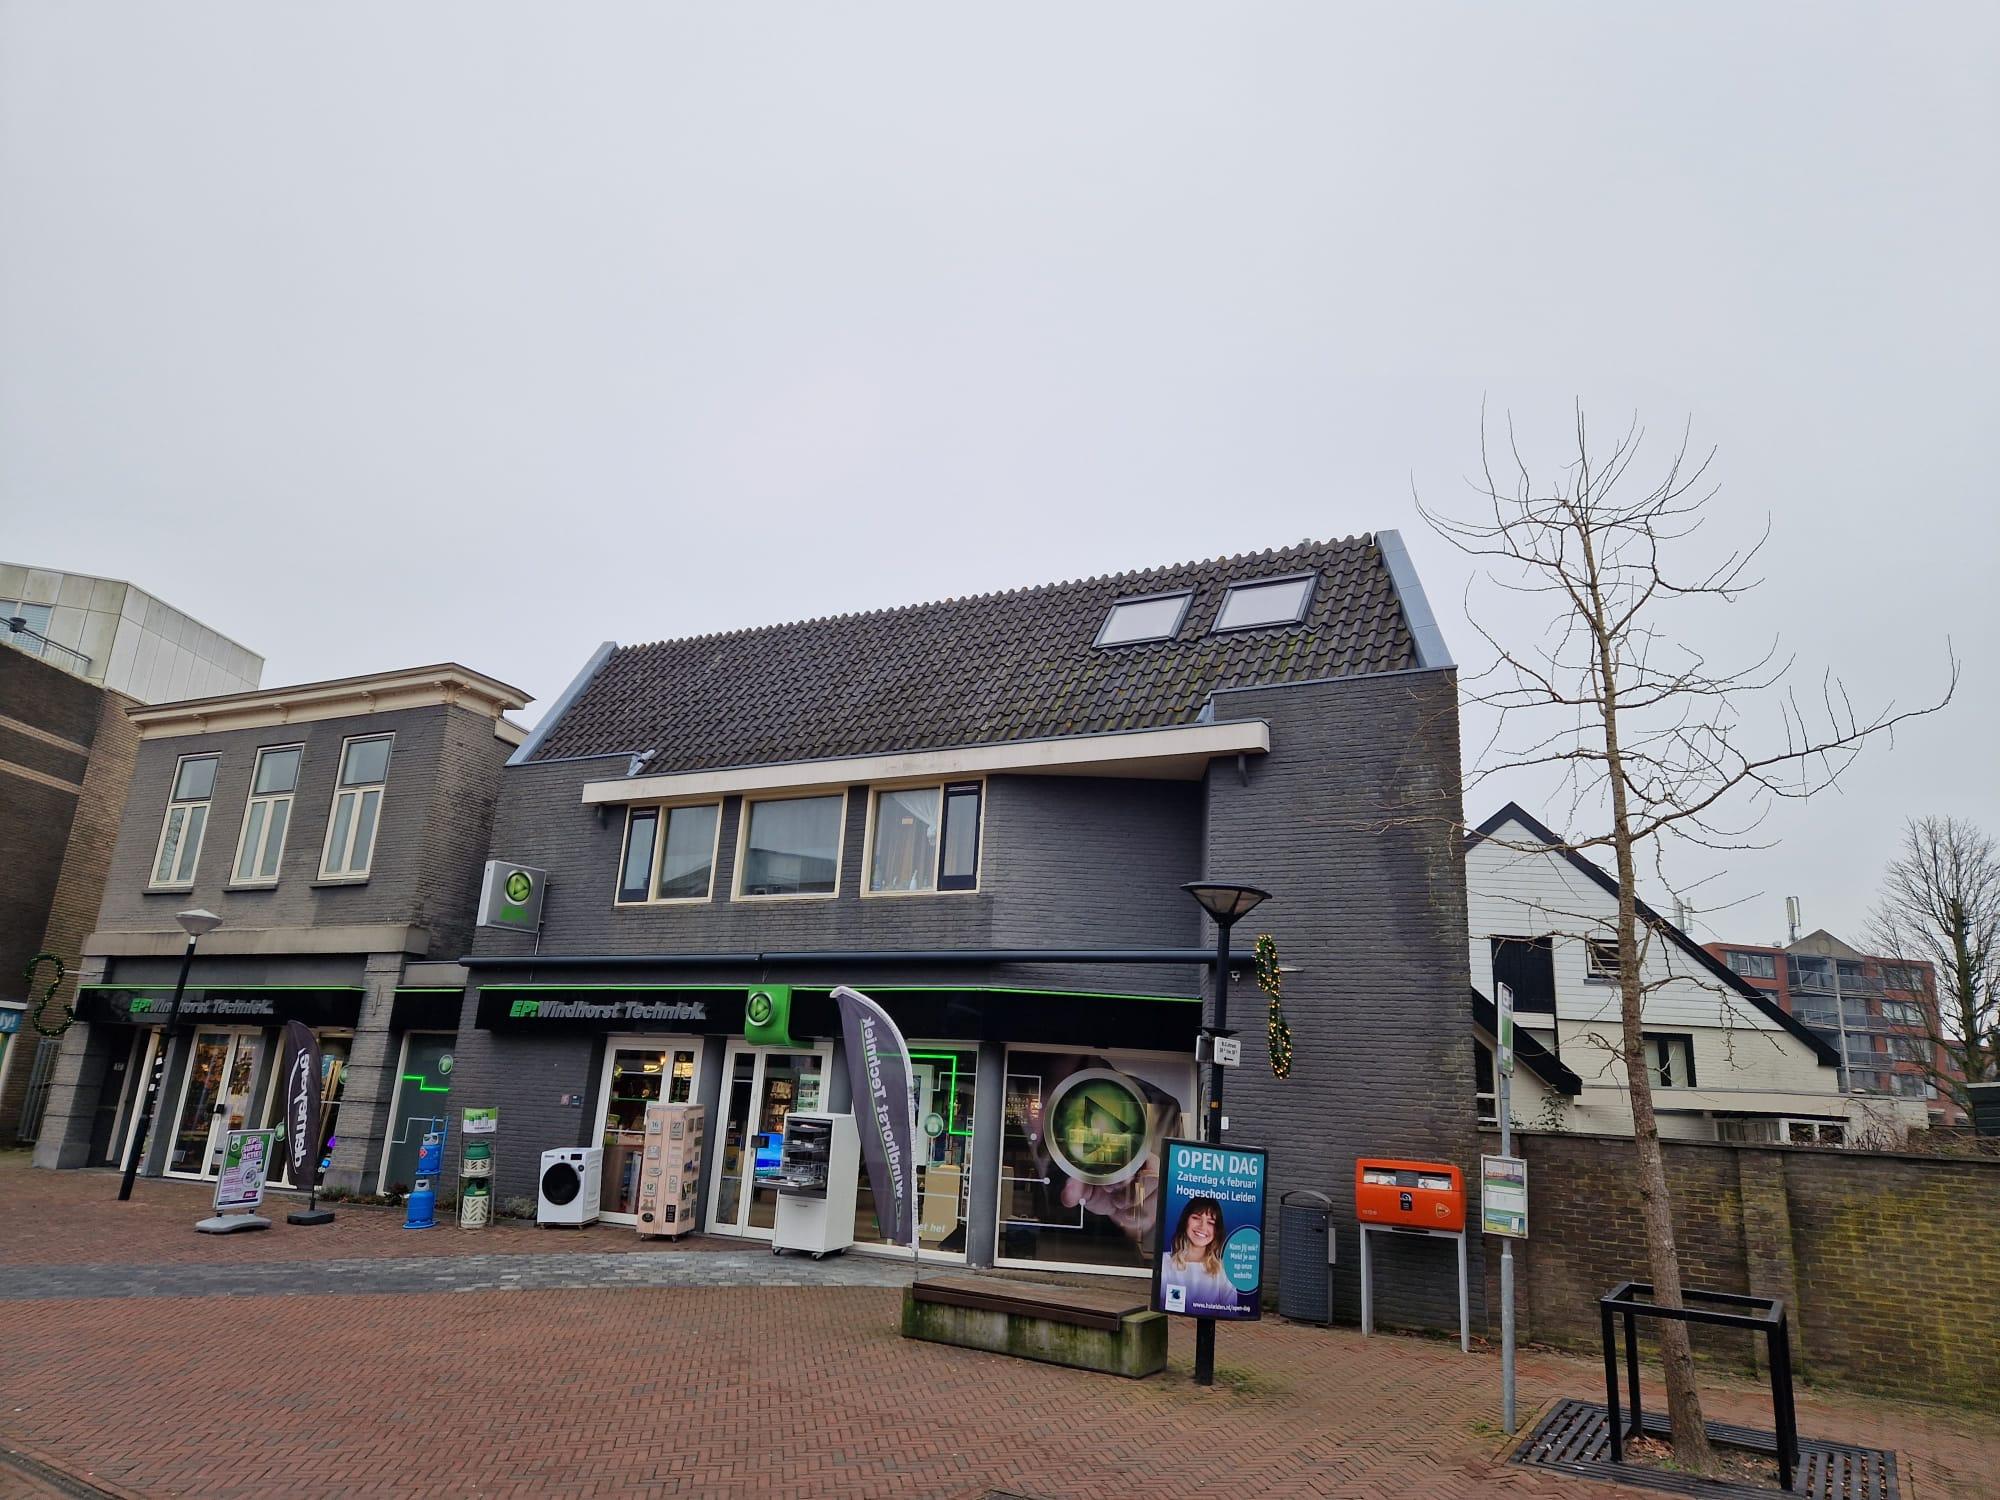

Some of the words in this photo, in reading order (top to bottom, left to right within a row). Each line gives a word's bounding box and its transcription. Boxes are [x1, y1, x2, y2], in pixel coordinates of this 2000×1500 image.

[129, 997, 211, 1014] EP:Winhorst
[212, 999, 274, 1014] Techniek
[624, 1001, 706, 1020] Techniek
[243, 1143, 262, 1152] SUPER
[1177, 1149, 1225, 1172] OPEN
[1229, 1155, 1258, 1176] DAG
[1177, 1171, 1217, 1187] Zaterdag
[1219, 1176, 1225, 1186] 4
[1227, 1177, 1256, 1189] februari
[1176, 1184, 1229, 1201] Hogeschool
[1231, 1191, 1256, 1203] Leiden
